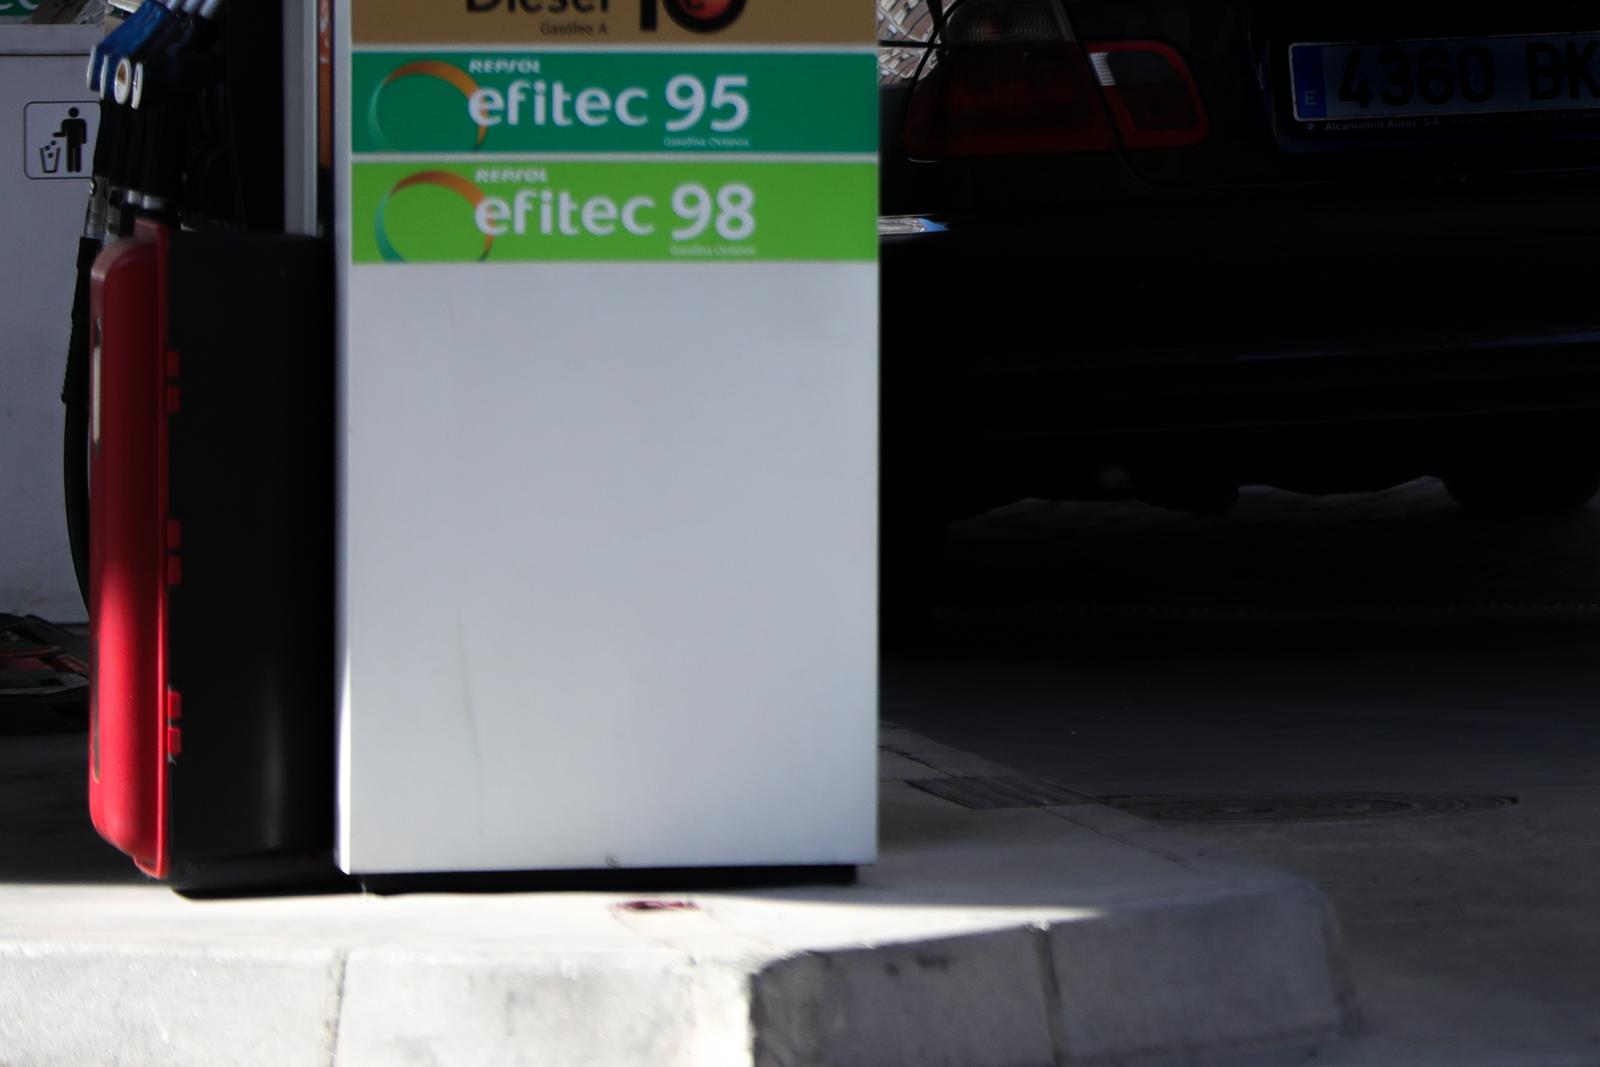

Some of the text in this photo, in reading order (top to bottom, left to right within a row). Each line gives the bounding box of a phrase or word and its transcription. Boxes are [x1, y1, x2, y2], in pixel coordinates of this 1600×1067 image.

[469, 59, 541, 74] REPSOL
[1338, 45, 1495, 109] 4360
[468, 74, 749, 132] efitec 95
[1304, 90, 1317, 106] E
[1324, 121, 1383, 131] Alcamadrid
[1387, 120, 1417, 129] Autos
[475, 169, 548, 184] REPSOL
[474, 183, 756, 242] efitec 98
